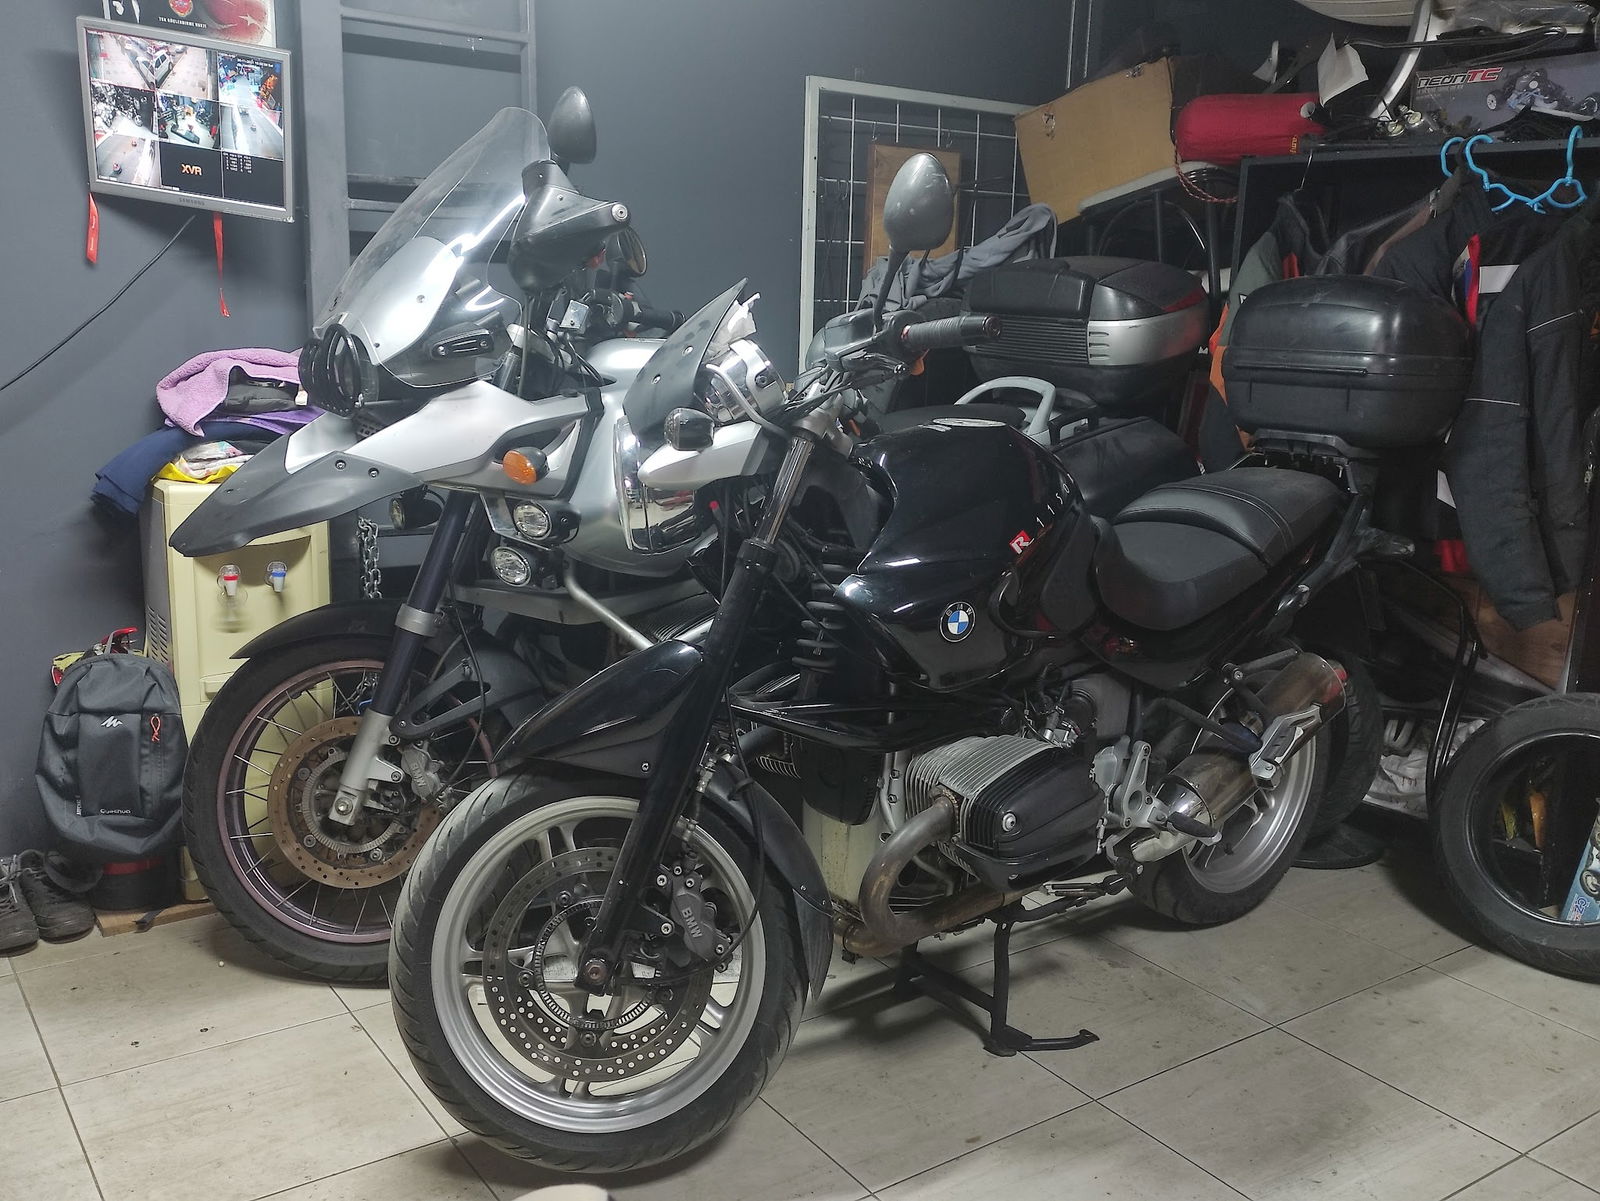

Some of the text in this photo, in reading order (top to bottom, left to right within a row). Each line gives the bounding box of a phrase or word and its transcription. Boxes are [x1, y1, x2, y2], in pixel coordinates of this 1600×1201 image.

[181, 164, 202, 176] XVR
[179, 197, 205, 206] SAMSUNG
[1011, 536, 1035, 554] R
[682, 907, 703, 938] BMW
